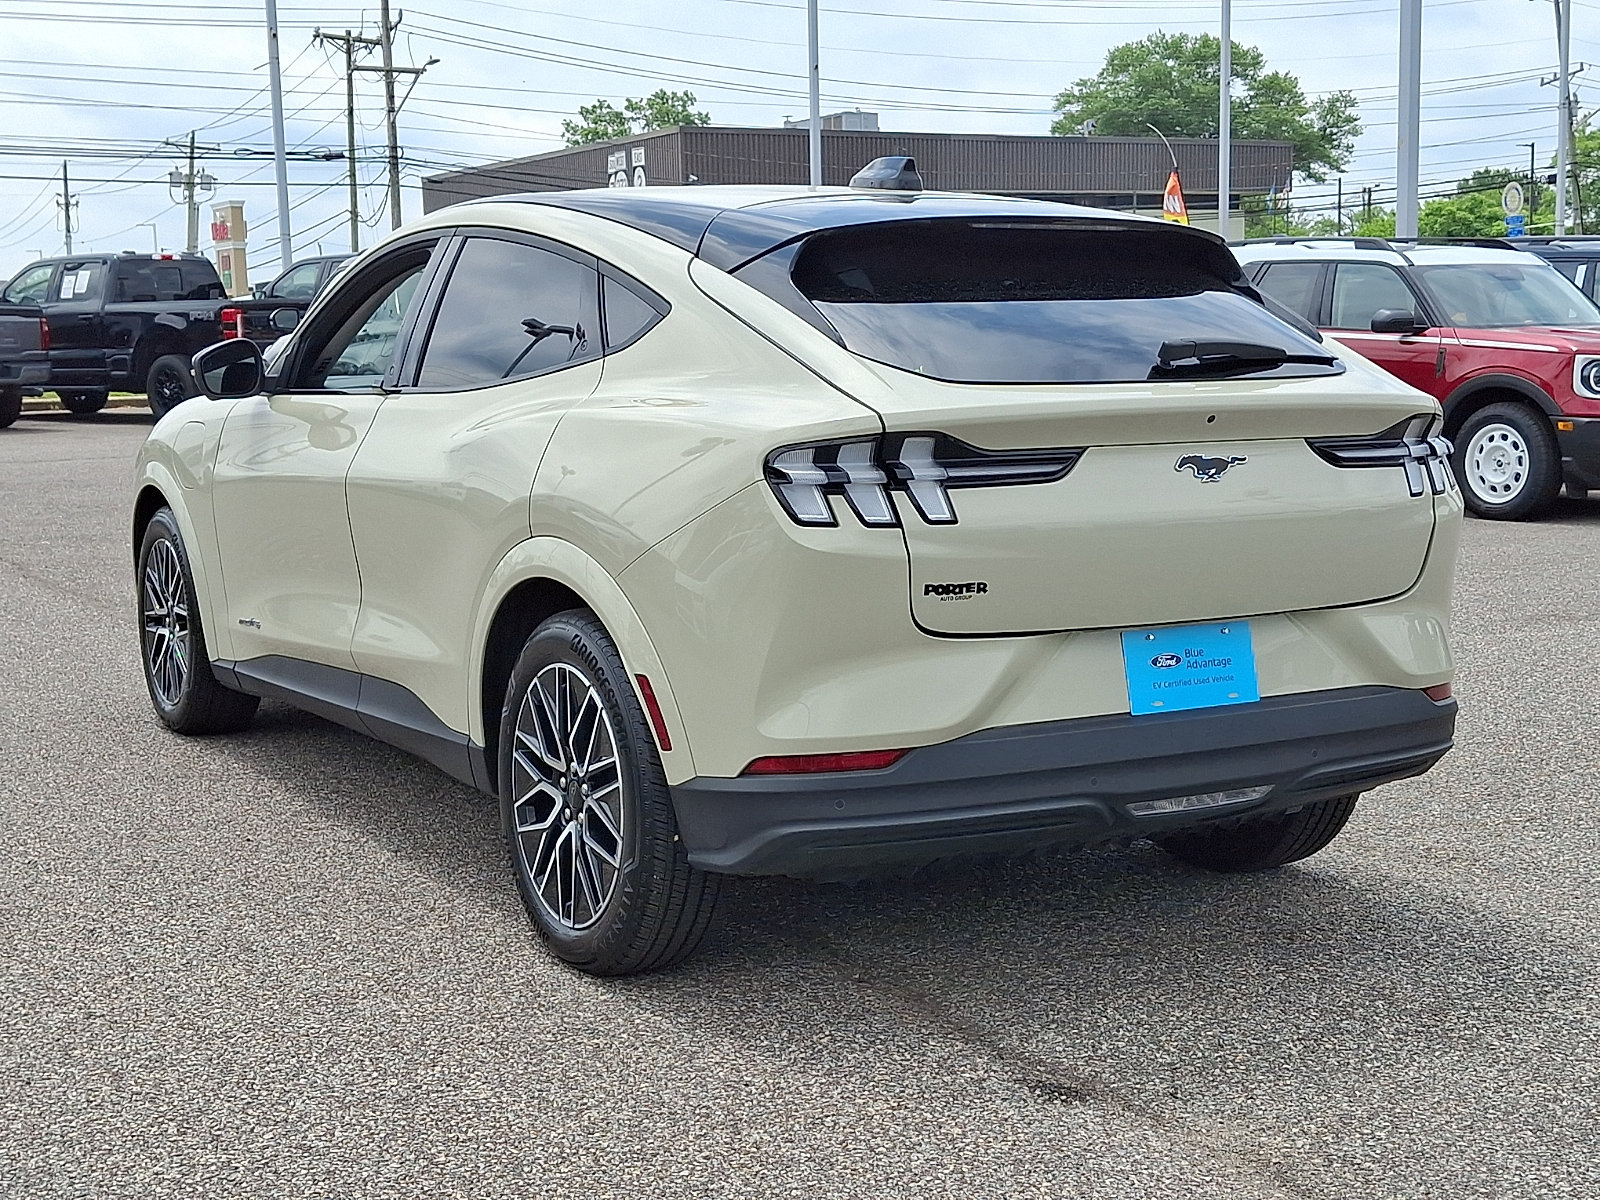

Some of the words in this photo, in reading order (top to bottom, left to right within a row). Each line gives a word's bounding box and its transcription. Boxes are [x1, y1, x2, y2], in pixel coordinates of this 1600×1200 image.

[923, 581, 988, 596] PORTER
[1184, 648, 1205, 659] Blue
[1154, 654, 1179, 668] Ford
[1186, 657, 1232, 669] Advantage
[1152, 682, 1162, 690] EV
[1163, 679, 1192, 688] Certified
[1193, 677, 1210, 685] Used
[1211, 674, 1235, 684] Vehicle
